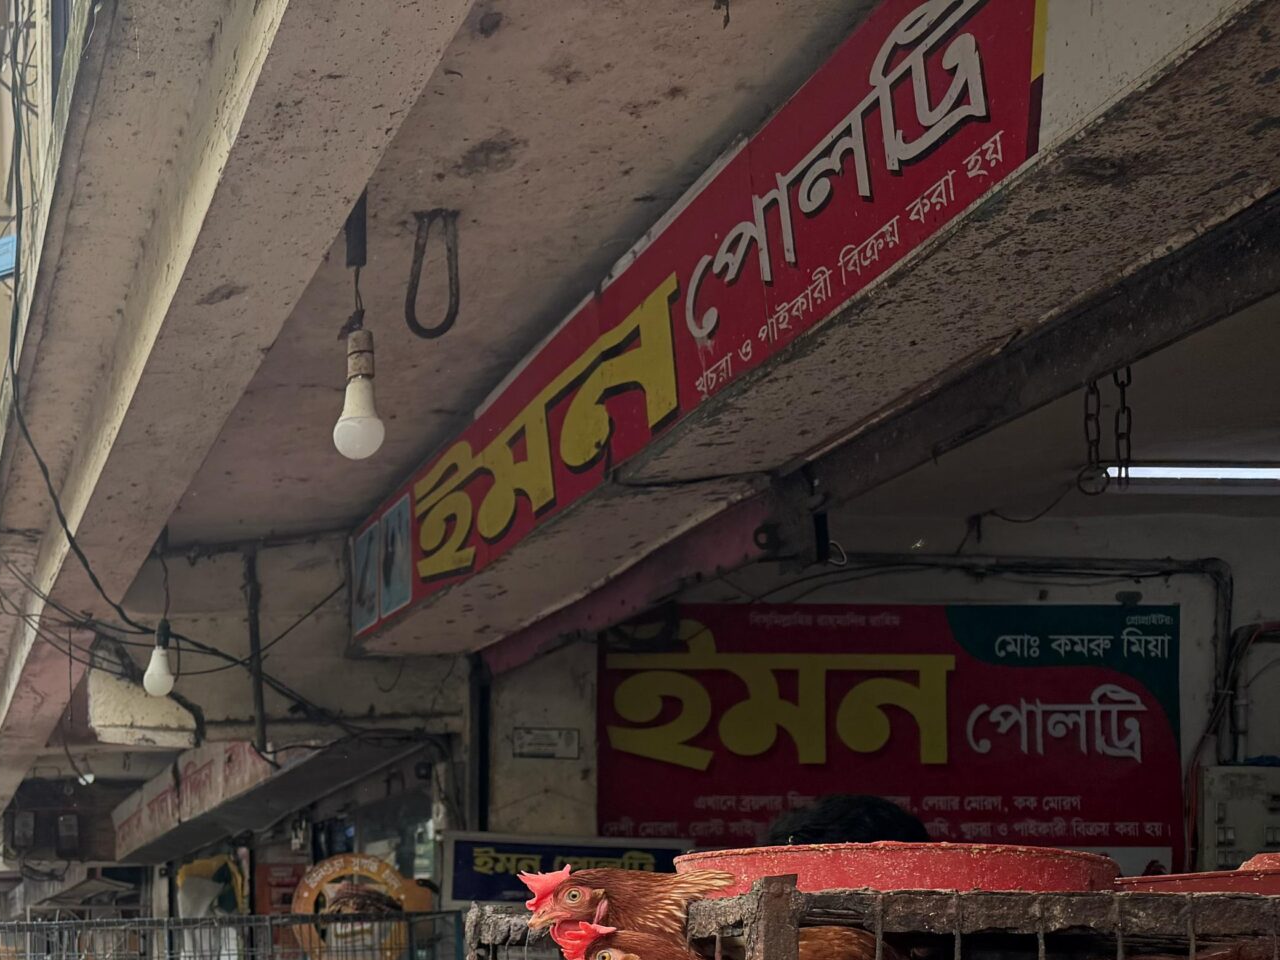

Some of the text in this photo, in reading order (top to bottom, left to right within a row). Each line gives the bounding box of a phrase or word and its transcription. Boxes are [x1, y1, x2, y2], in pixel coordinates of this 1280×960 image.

[737, 340, 752, 362] ও
[758, 266, 834, 346] পাইকারী
[838, 214, 901, 286] বিক্রয়
[905, 168, 957, 225] করা
[962, 129, 1005, 180] হয়
[414, 271, 678, 577] ইমন
[994, 627, 1172, 660] মোঃ কমরু মিয়া
[606, 618, 956, 772] ইমন
[1012, 795, 1038, 810] কক
[1042, 795, 1083, 811] মোরগ
[996, 821, 1008, 836] ও
[1071, 817, 1111, 838] বিক্রয়
[1114, 821, 1141, 838] করা
[473, 846, 542, 875] ইমন
